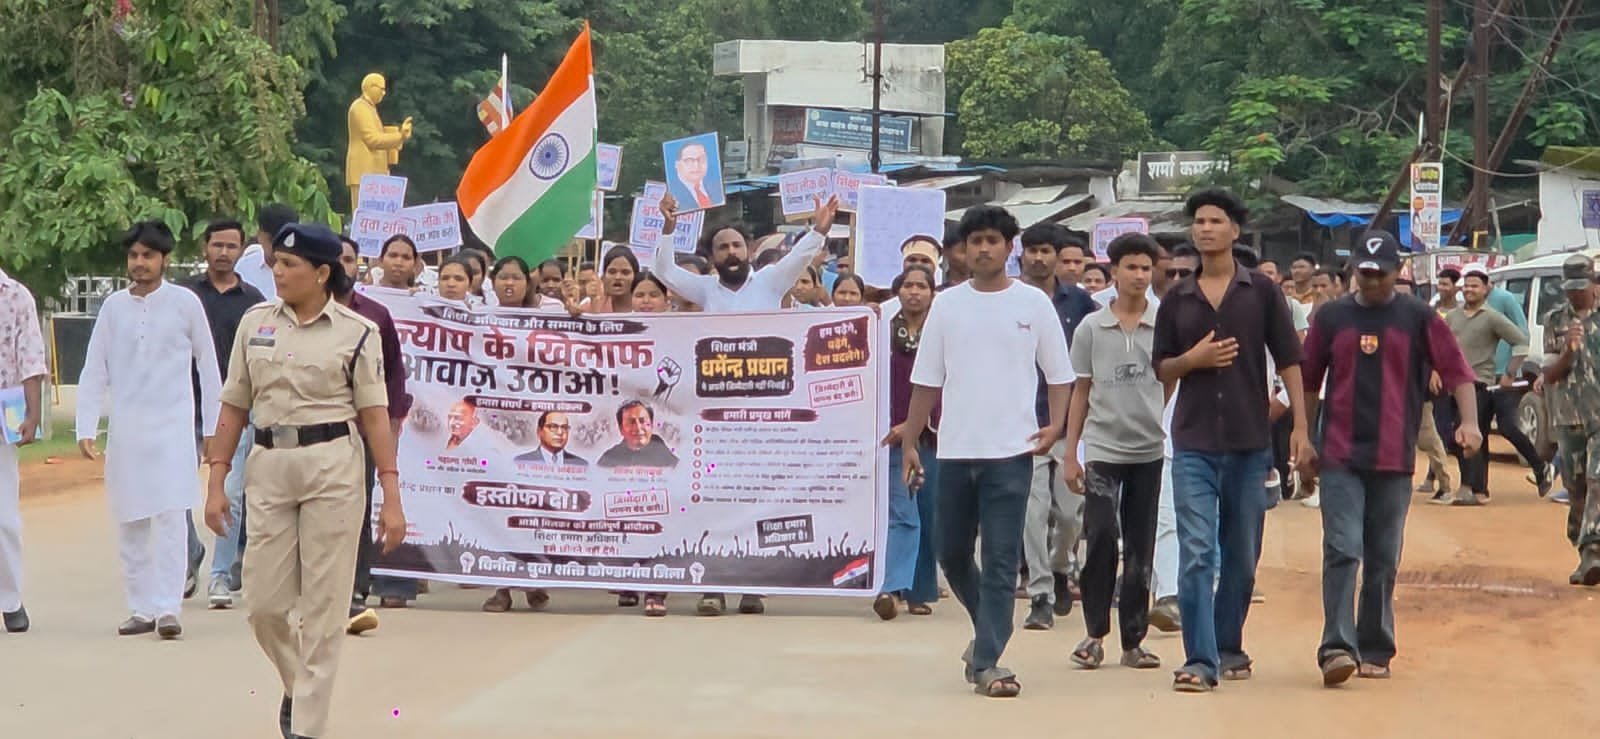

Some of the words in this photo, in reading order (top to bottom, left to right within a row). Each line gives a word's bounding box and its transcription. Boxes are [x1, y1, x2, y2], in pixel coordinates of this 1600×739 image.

[1147, 153, 1176, 180] शर्मा
[524, 316, 544, 330] और
[548, 320, 582, 332] सम्मान
[586, 321, 597, 334] के
[600, 321, 624, 333] लिए
[483, 327, 516, 361] के
[527, 329, 655, 369] खिलाफ
[711, 340, 736, 352] शिक्षा
[738, 339, 757, 352] मंत्री
[745, 357, 788, 376] प्रधान
[506, 364, 620, 396] उठाओ!
[723, 410, 748, 421] हमारी
[749, 410, 771, 422] प्रमुख
[475, 484, 546, 508] इस्तीफा
[548, 487, 578, 510] दो!
[519, 518, 538, 526] आओ
[784, 518, 807, 530] हमारा
[534, 530, 557, 541] शिक्षा
[560, 533, 583, 542] हमारा
[586, 532, 618, 544] अधिकार
[478, 554, 517, 573] विनीत
[527, 561, 551, 578] युवा
[554, 560, 585, 577] शक्ति
[653, 563, 686, 580] जिला
